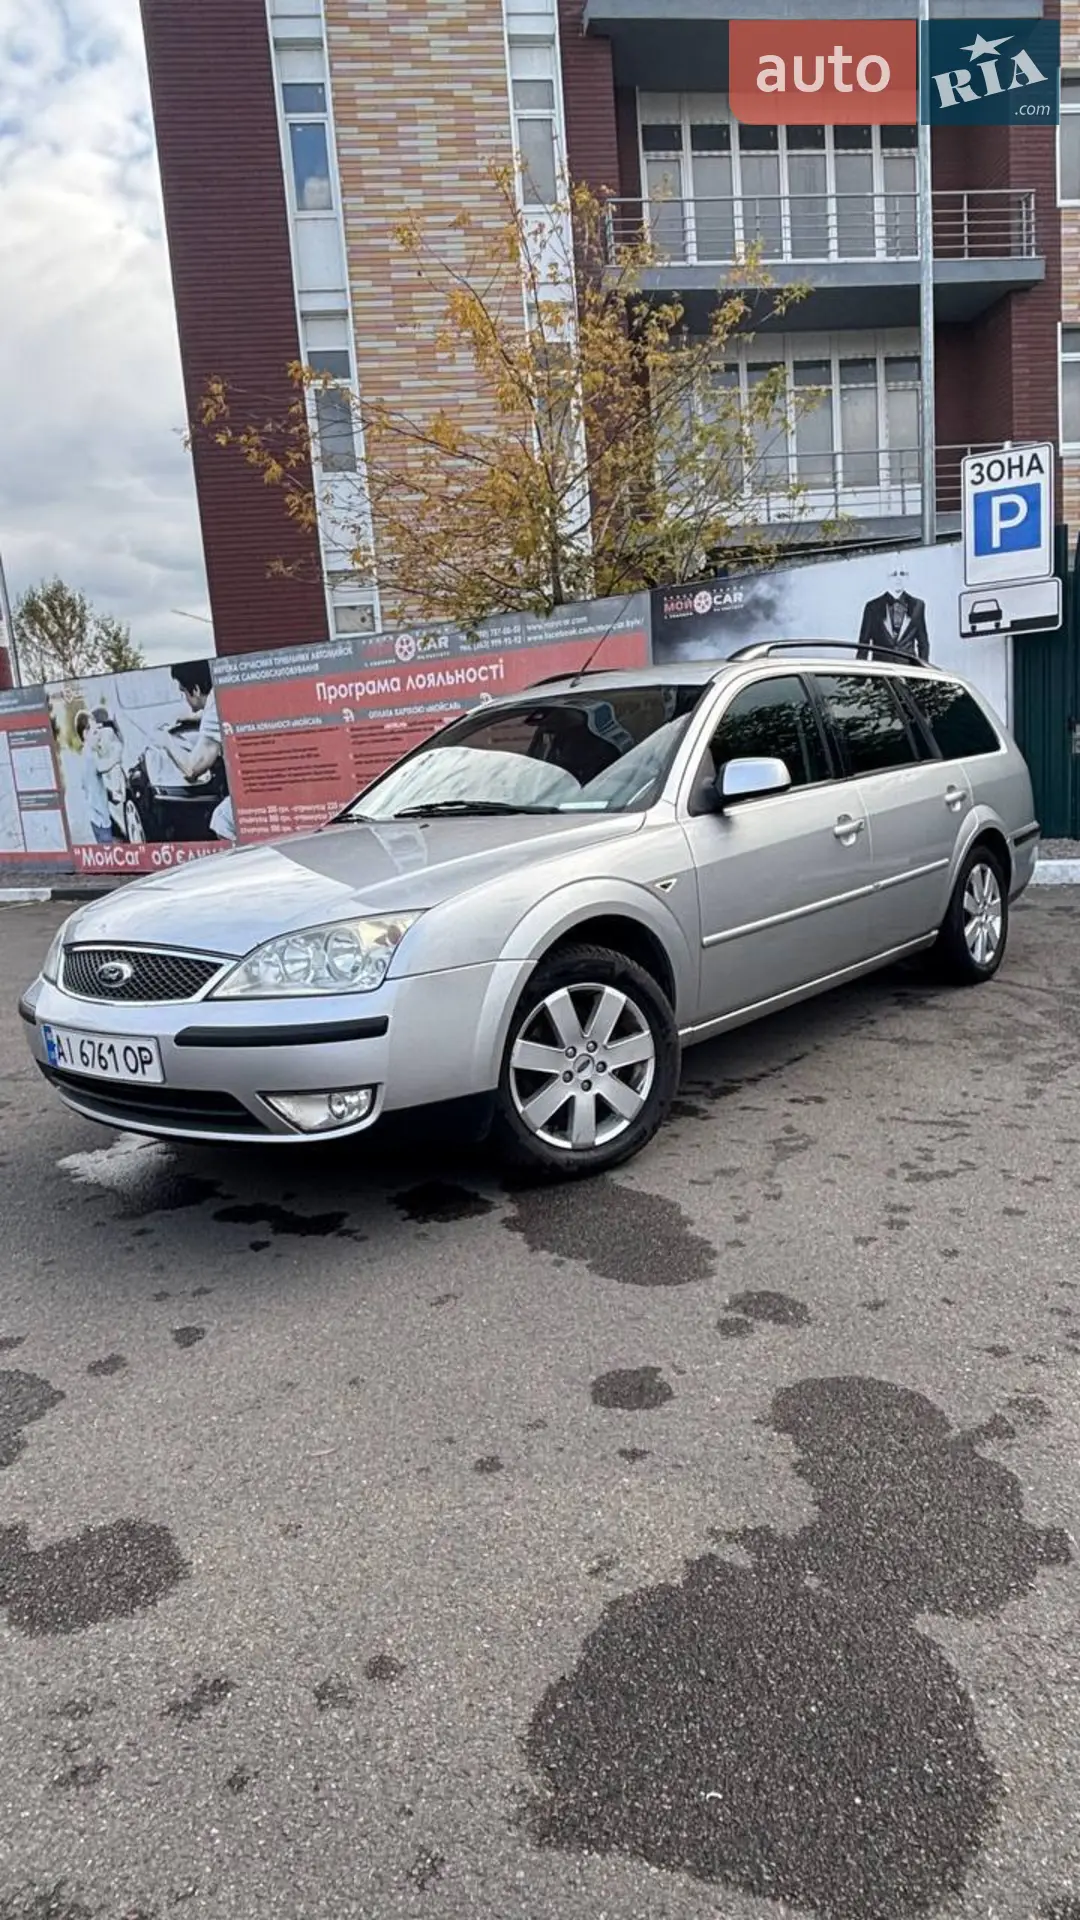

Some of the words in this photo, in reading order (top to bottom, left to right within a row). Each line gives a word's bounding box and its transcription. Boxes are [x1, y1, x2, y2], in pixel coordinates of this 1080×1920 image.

[970, 453, 1045, 485] ЗОНА
[992, 493, 1028, 548] P
[713, 592, 744, 606] CAR
[316, 677, 401, 704] Програма
[406, 657, 505, 691] лояльності
[56, 1034, 75, 1065] AI
[79, 1038, 120, 1074] 6761
[123, 1045, 153, 1076] OP
